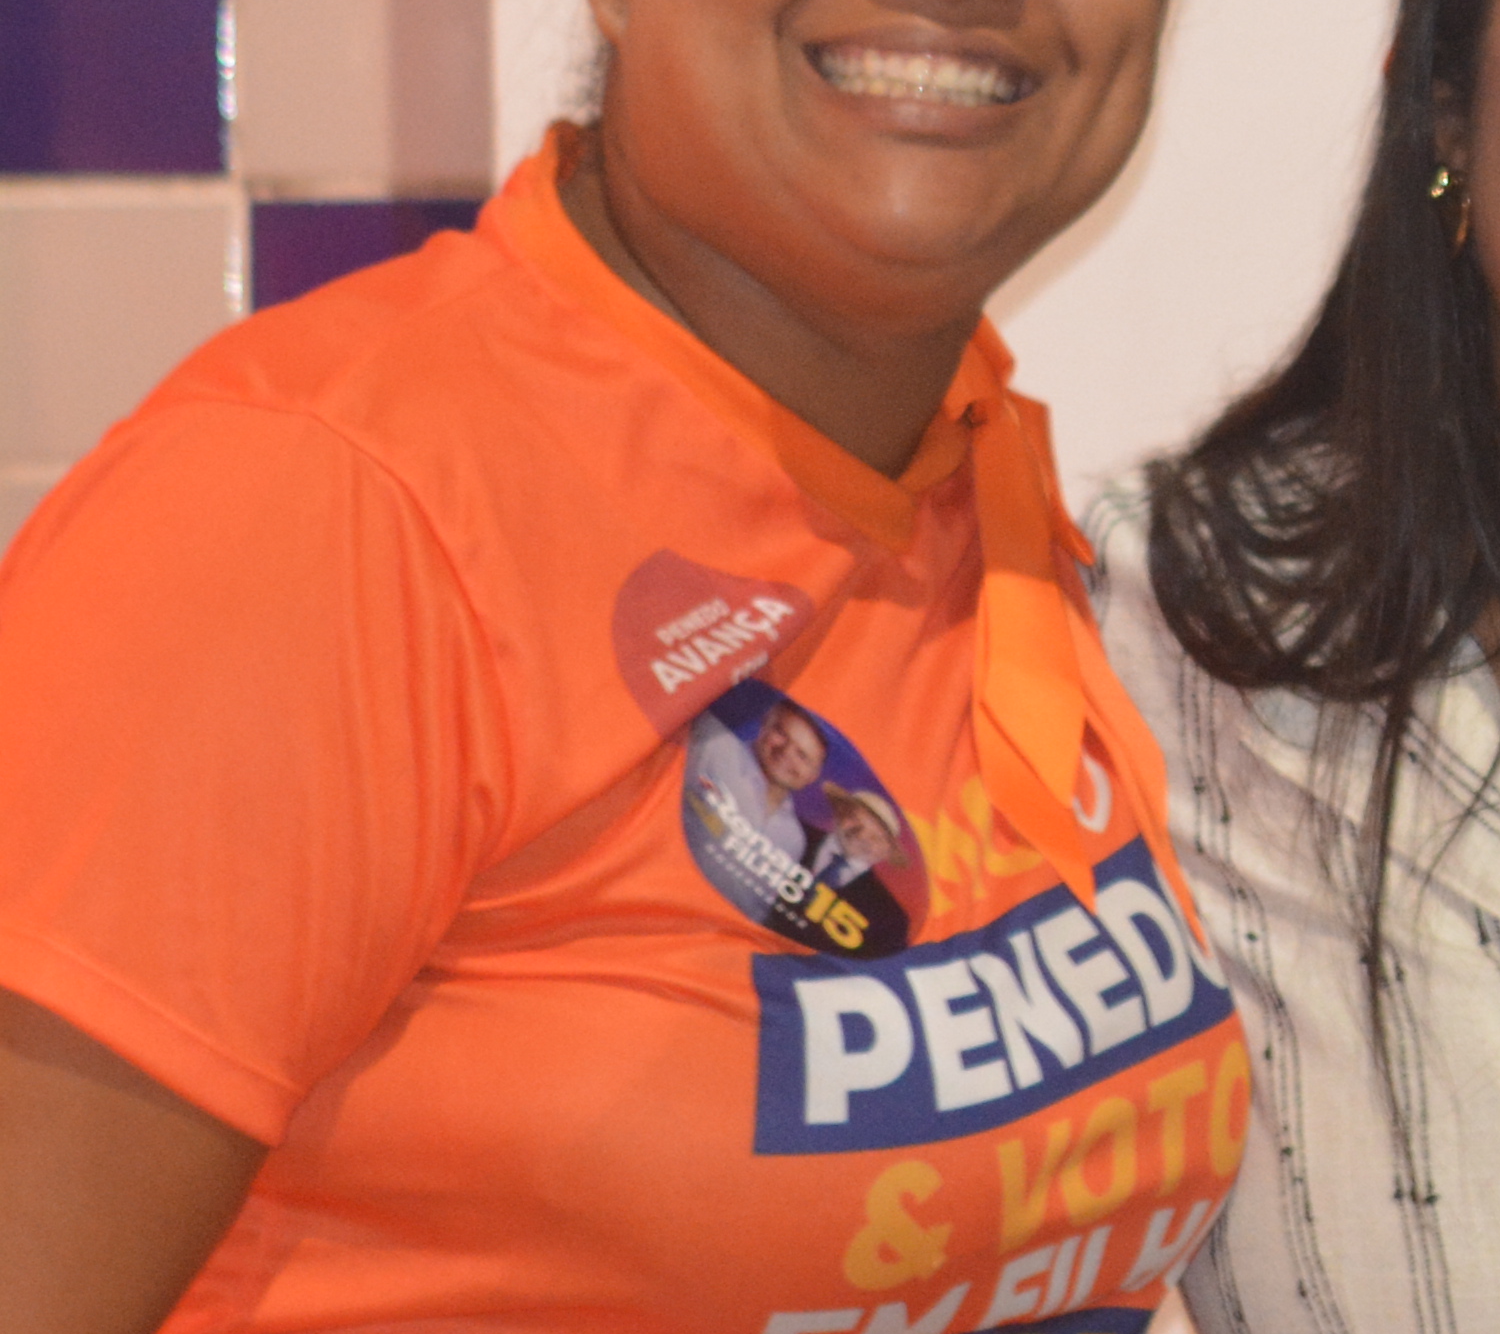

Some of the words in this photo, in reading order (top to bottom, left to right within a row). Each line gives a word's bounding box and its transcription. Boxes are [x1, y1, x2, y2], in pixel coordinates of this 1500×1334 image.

[649, 595, 797, 695] AVANÇA
[723, 831, 806, 905] FILHO
[805, 881, 869, 950] 15
[842, 1160, 954, 1292] &
